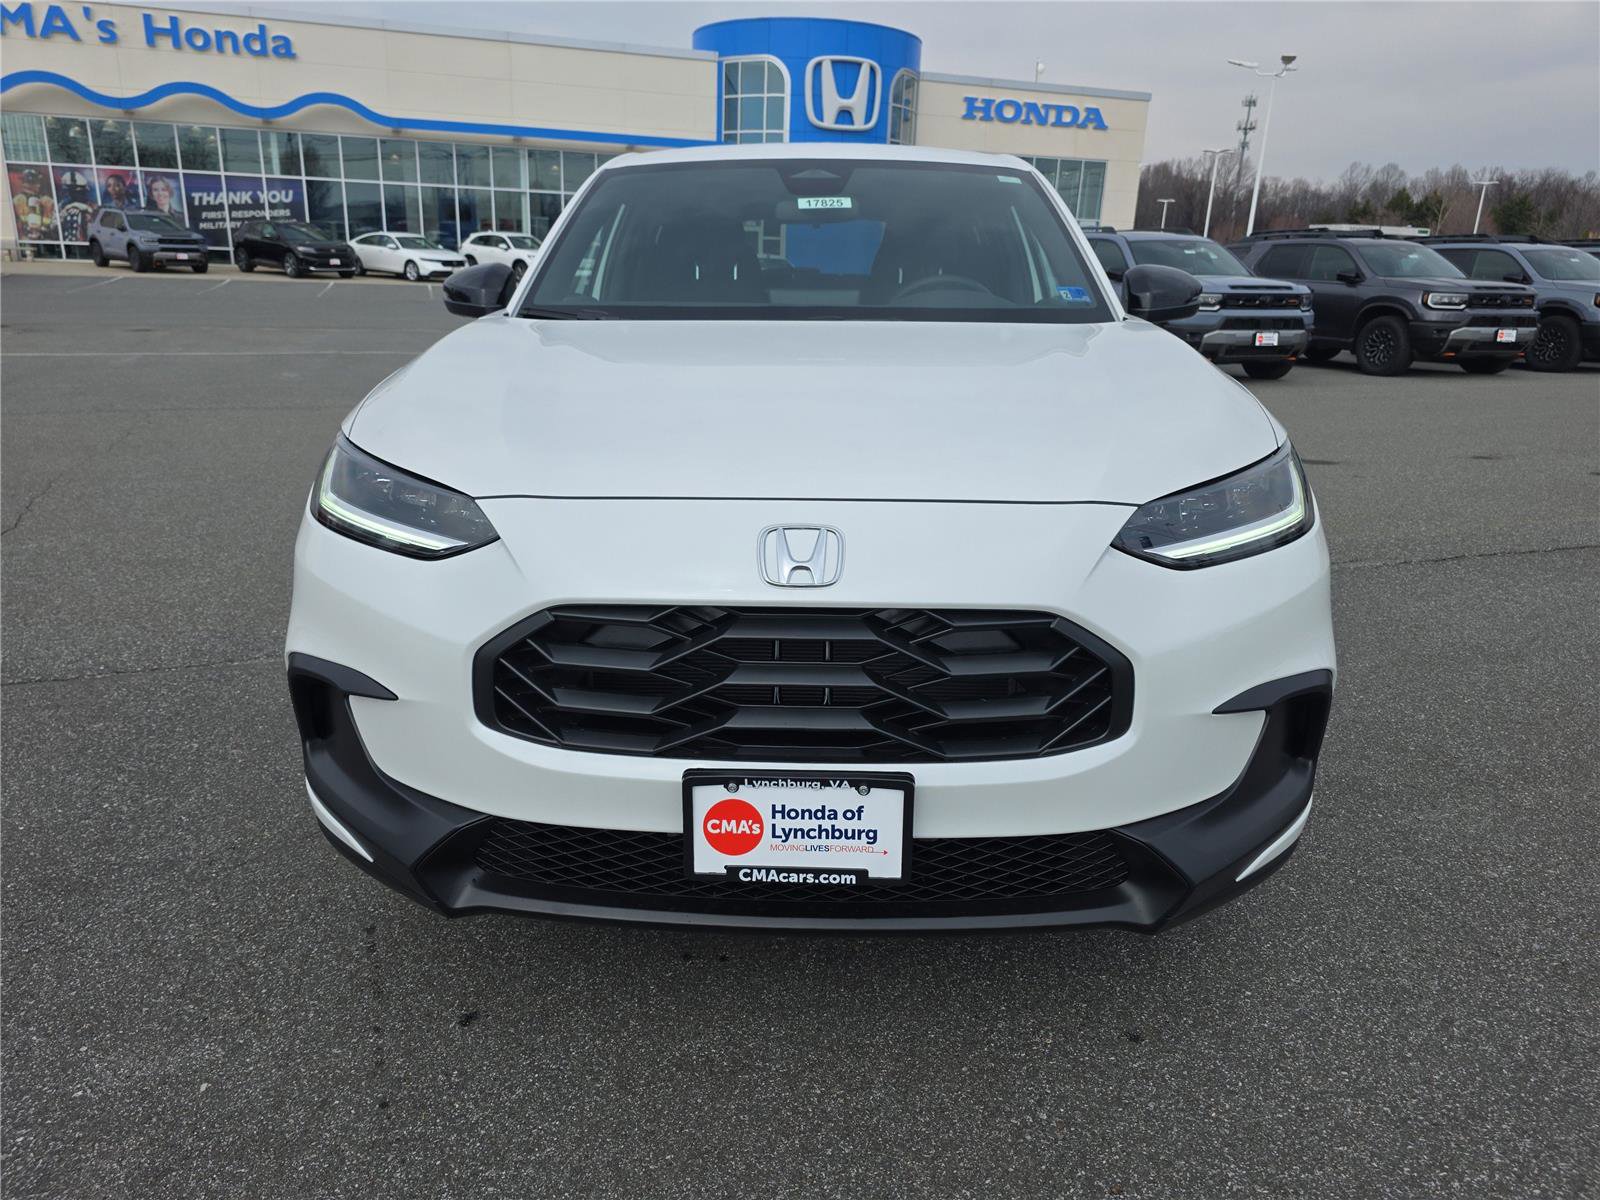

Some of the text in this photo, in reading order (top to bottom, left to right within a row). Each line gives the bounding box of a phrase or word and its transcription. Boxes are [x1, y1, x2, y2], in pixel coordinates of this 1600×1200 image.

[142, 13, 297, 59] Honda
[961, 96, 1109, 130] HONDA
[191, 189, 293, 206] THANK YOU
[805, 199, 844, 208] 17825
[202, 208, 291, 219] FIRST RESPONDERS
[744, 778, 851, 790] Lynchburg, VA
[771, 803, 865, 821] Honda of
[706, 819, 761, 835] CMA's
[771, 823, 878, 845] Lynchburg
[738, 868, 857, 885] CMAcars.com
